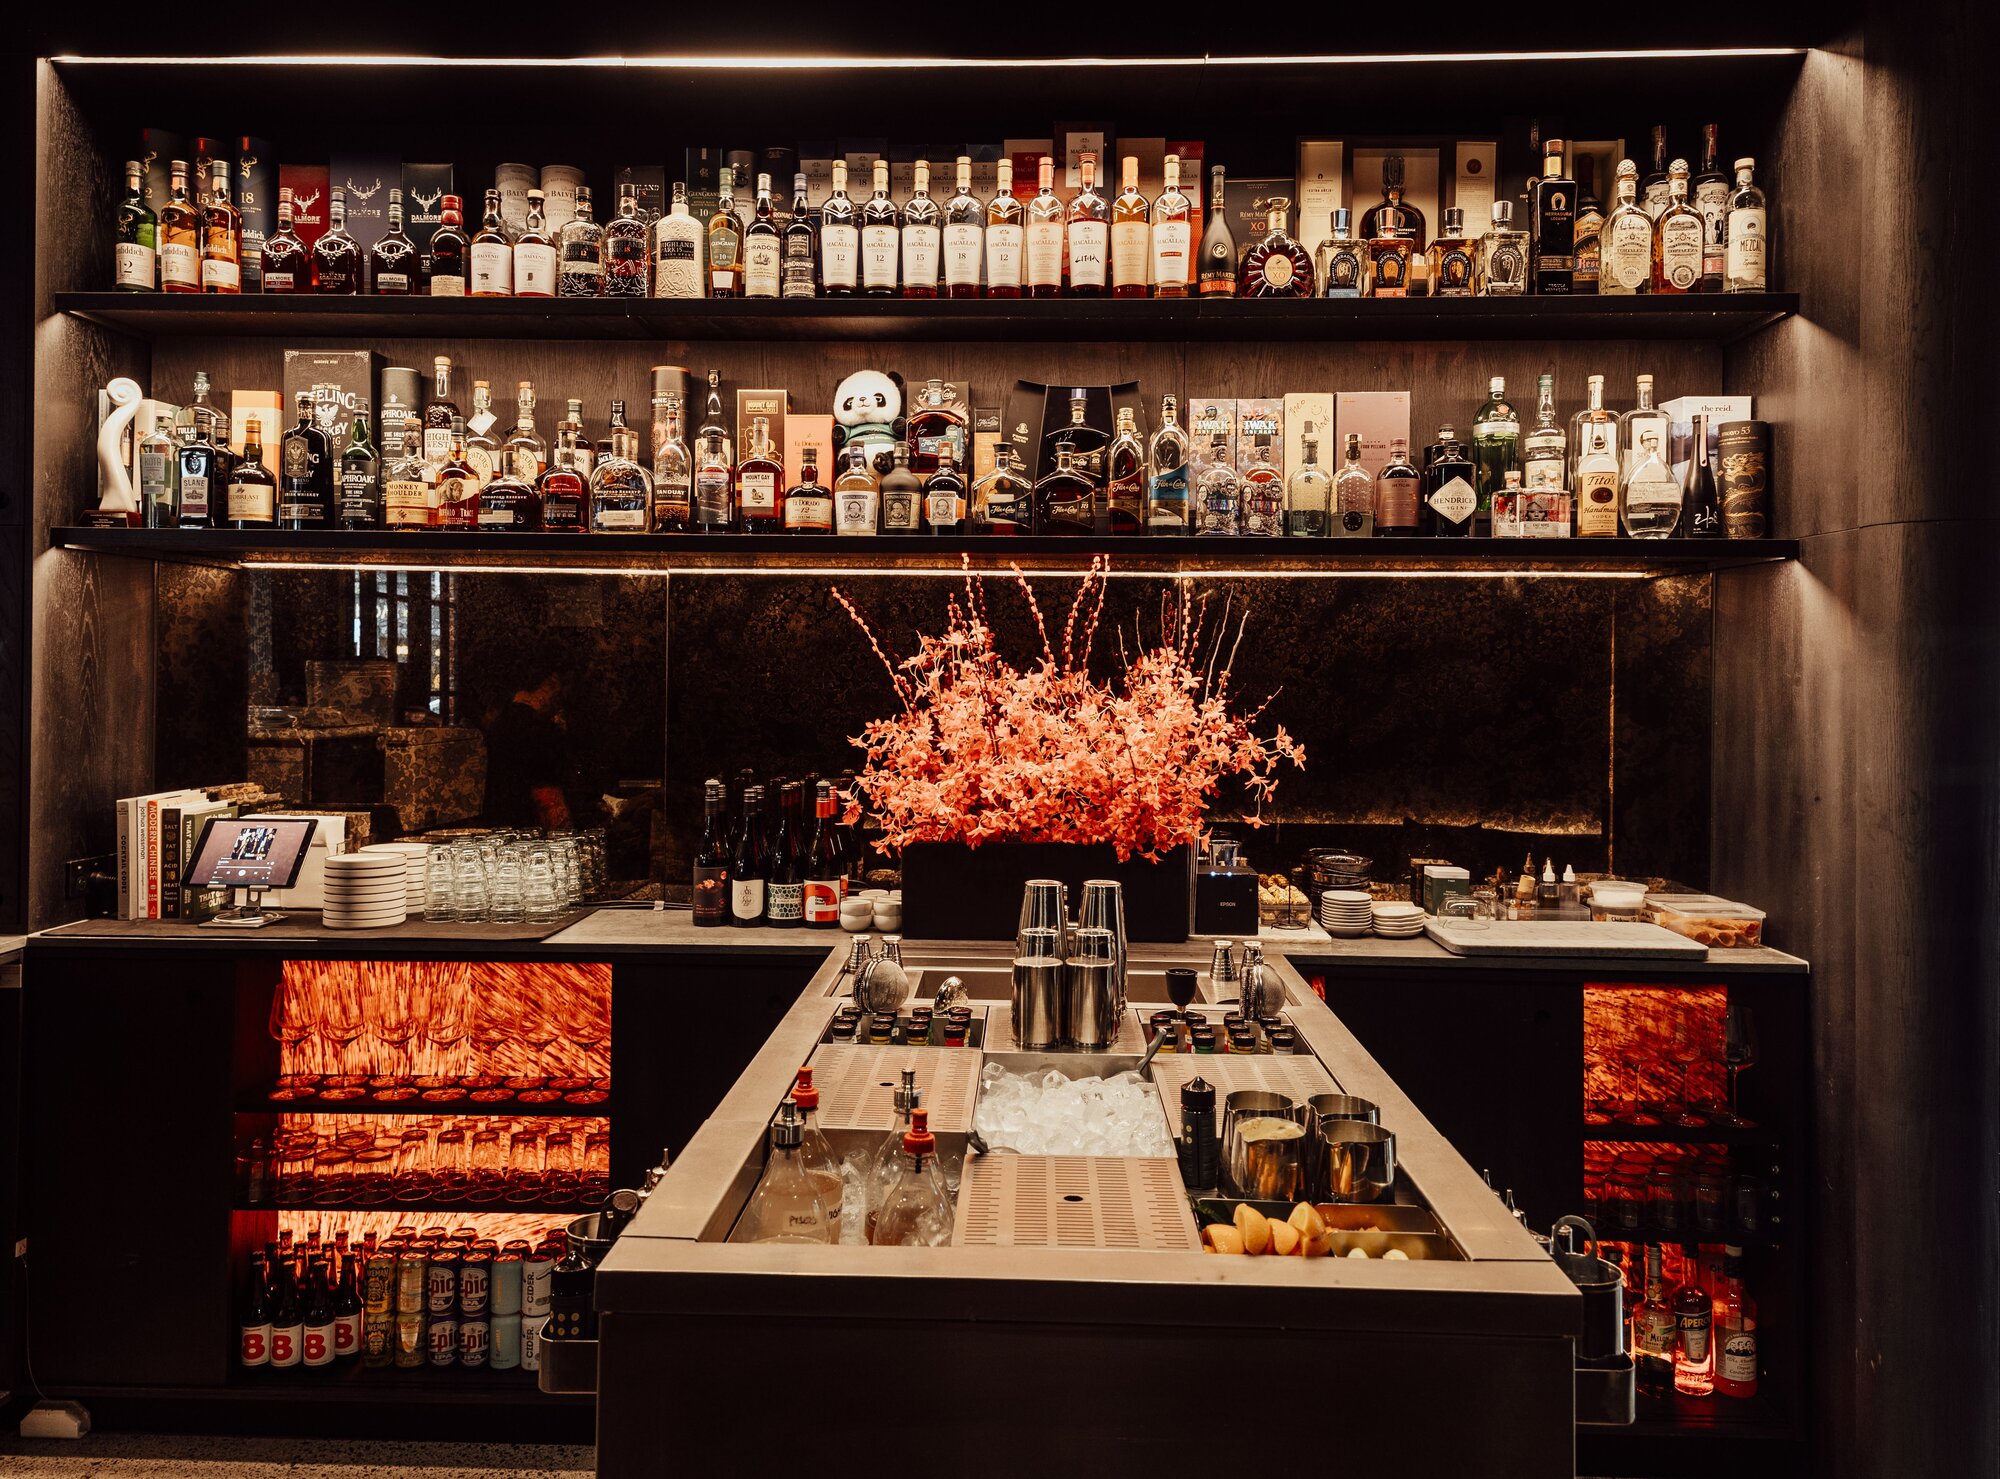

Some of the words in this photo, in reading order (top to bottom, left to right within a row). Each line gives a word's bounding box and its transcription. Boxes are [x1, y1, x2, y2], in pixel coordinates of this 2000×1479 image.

[812, 183, 820, 191] 12
[858, 178, 867, 187] 18
[903, 186, 912, 194] 15
[196, 193, 209, 204] 15
[241, 192, 254, 204] 18
[348, 209, 381, 217] DALMORE
[699, 208, 709, 217] 10
[1250, 221, 1266, 231] XO
[826, 241, 856, 249] MACALLAN
[865, 241, 895, 249] MACALLAN
[906, 241, 936, 249] MACALLAN
[949, 239, 977, 248] MACALLAN
[989, 241, 1019, 249] MACALLAN
[1740, 239, 1762, 252] MEZCAL
[117, 244, 144, 256] fiddich
[162, 246, 189, 258] fiddich
[203, 243, 228, 254] fiddich
[719, 253, 727, 261] 10
[836, 253, 846, 262] 12
[875, 254, 885, 262] 12
[916, 253, 925, 262] 15
[958, 252, 967, 260] 18
[999, 253, 1009, 262] 12
[118, 260, 133, 274] 12
[164, 260, 180, 274] 15
[423, 259, 430, 267] 15
[1216, 270, 1236, 279] MARTIN
[426, 433, 449, 441] HIGH
[183, 479, 206, 487] SLANE
[1152, 479, 1169, 490] Flor
[1587, 475, 1616, 486] Tito's
[800, 506, 810, 514] 12
[149, 805, 157, 842] MODERN
[149, 844, 157, 881] CHINESE
[527, 1271, 535, 1303] CIDER.
[526, 1326, 534, 1359] CIDER.
